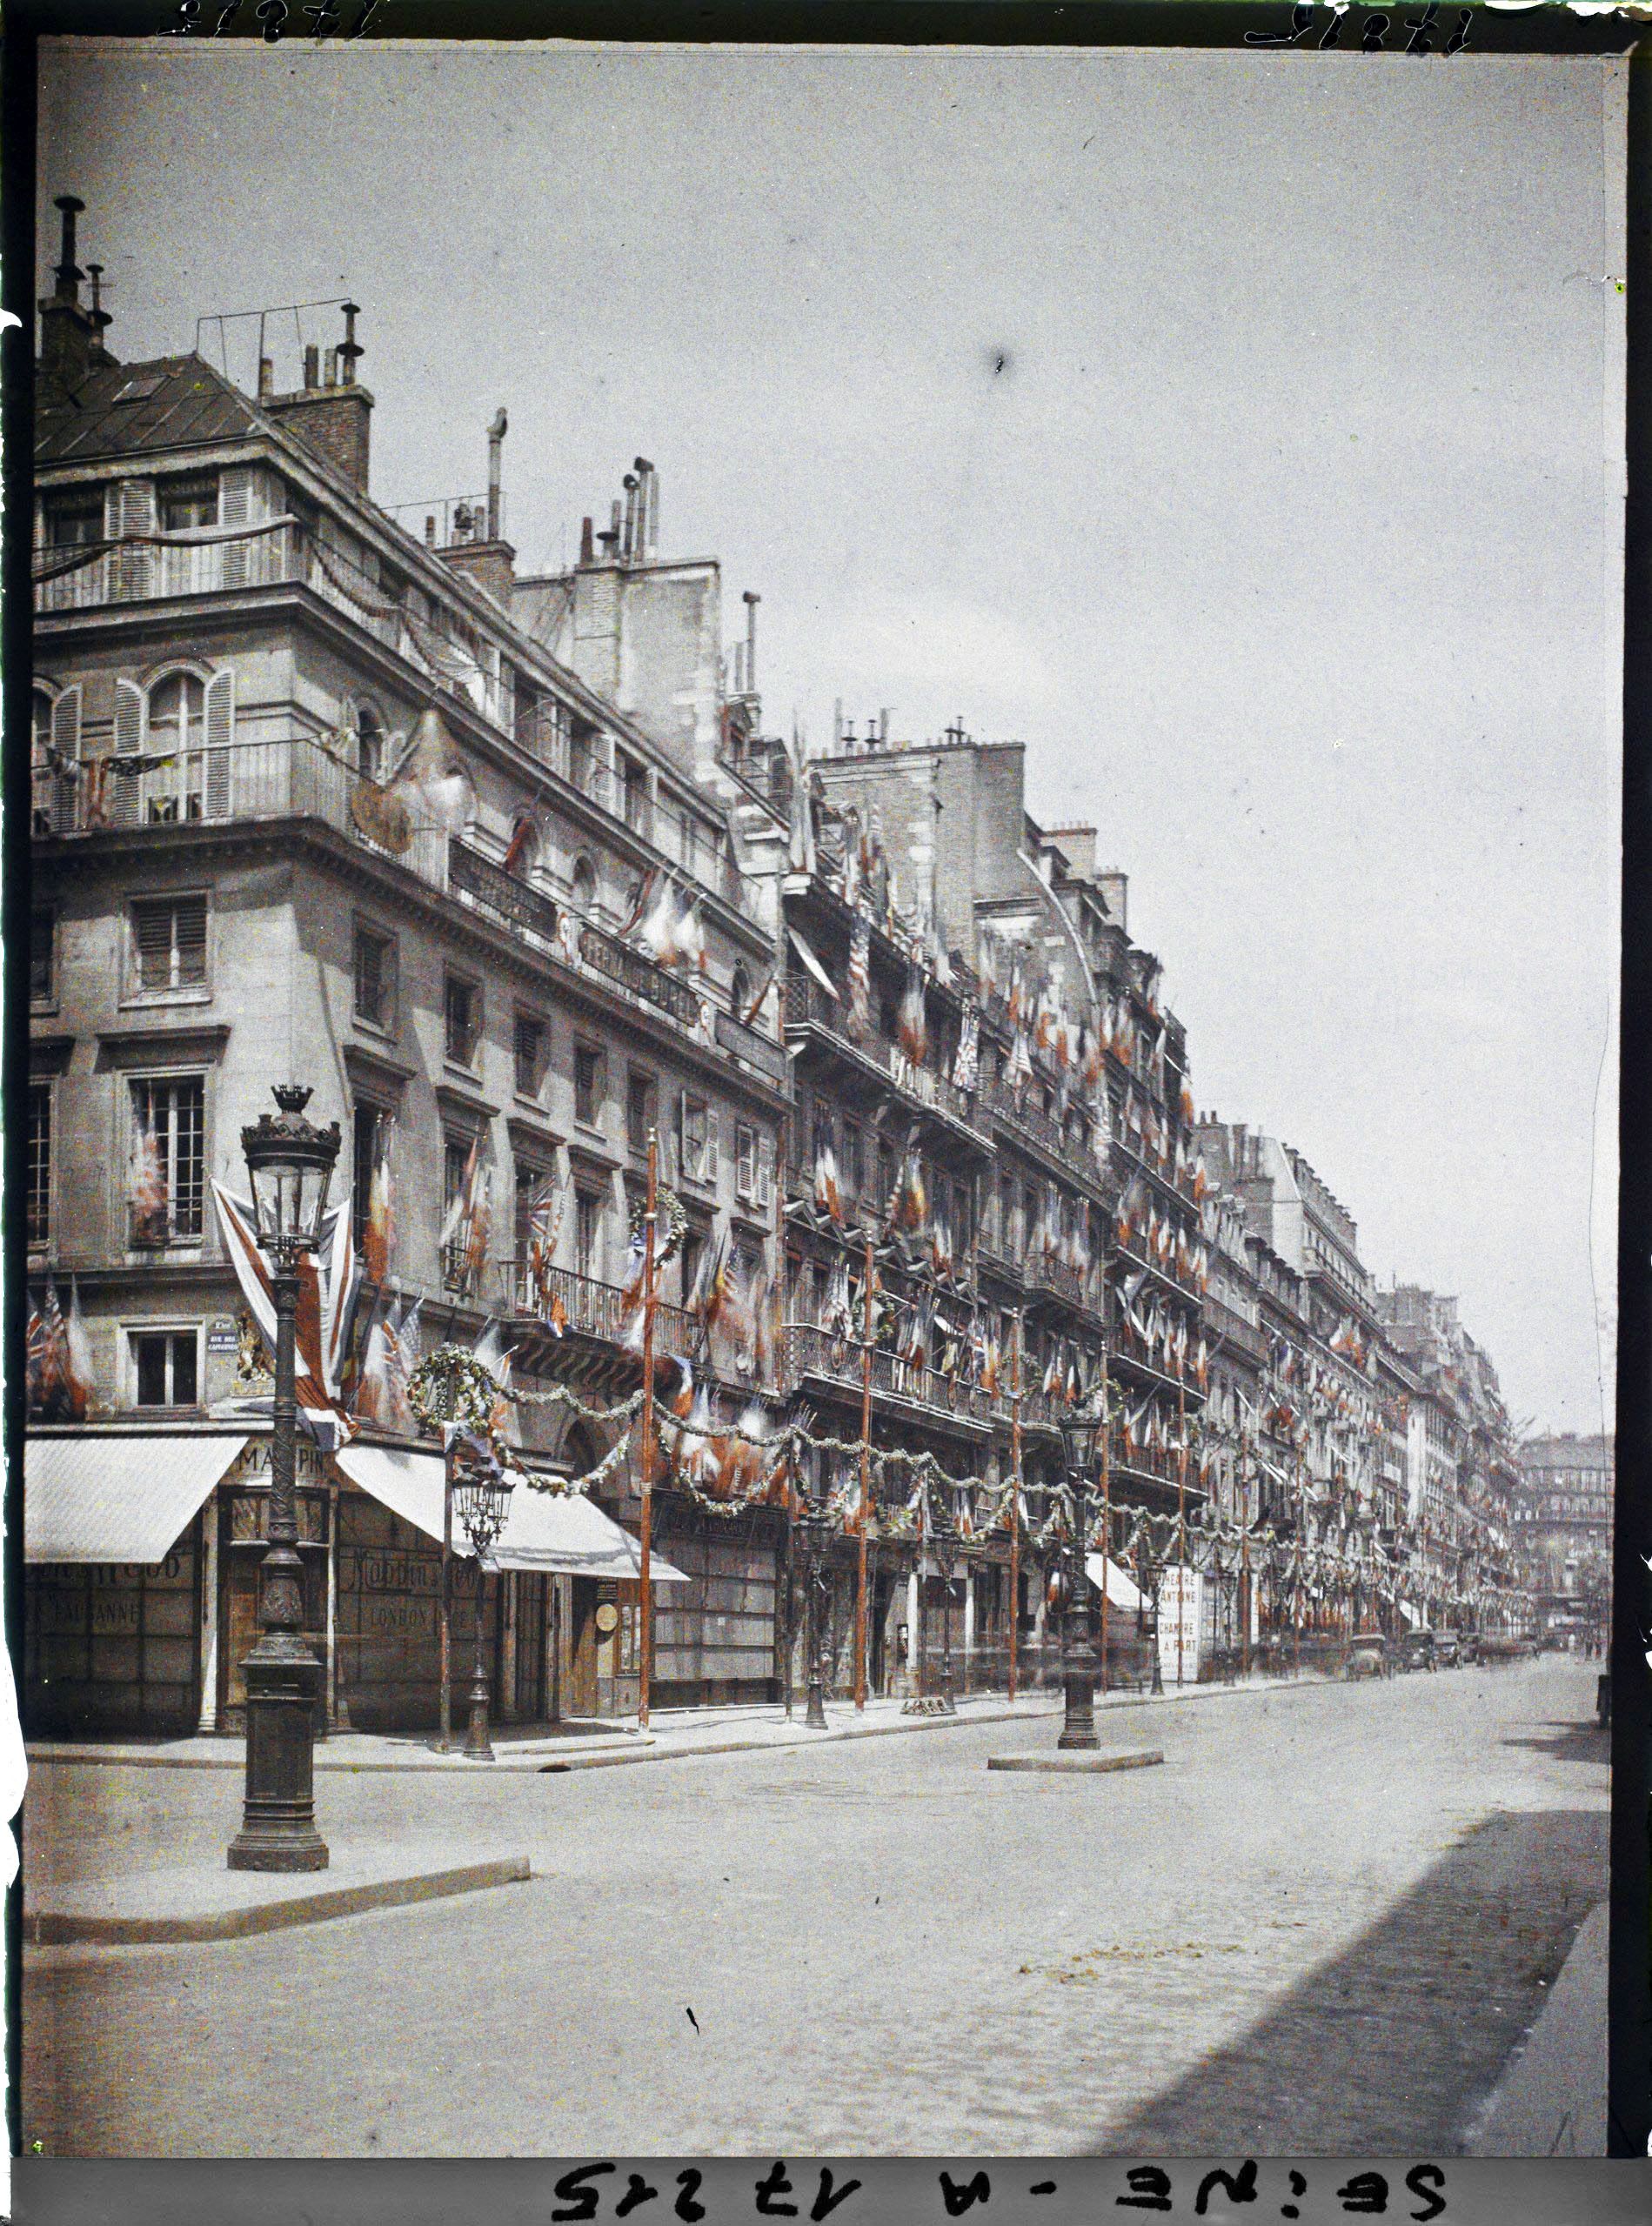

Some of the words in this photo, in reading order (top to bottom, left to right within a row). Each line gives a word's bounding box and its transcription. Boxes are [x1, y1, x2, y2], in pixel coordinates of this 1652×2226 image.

[238, 1447, 324, 1474] MAPIN
[1160, 1574, 1194, 1586] THEARE
[1160, 1590, 1195, 1603] ANTONE
[1159, 1622, 1194, 1635] CHAMRE
[755, 2161, 862, 2222] 17
[939, 2171, 990, 2216] A
